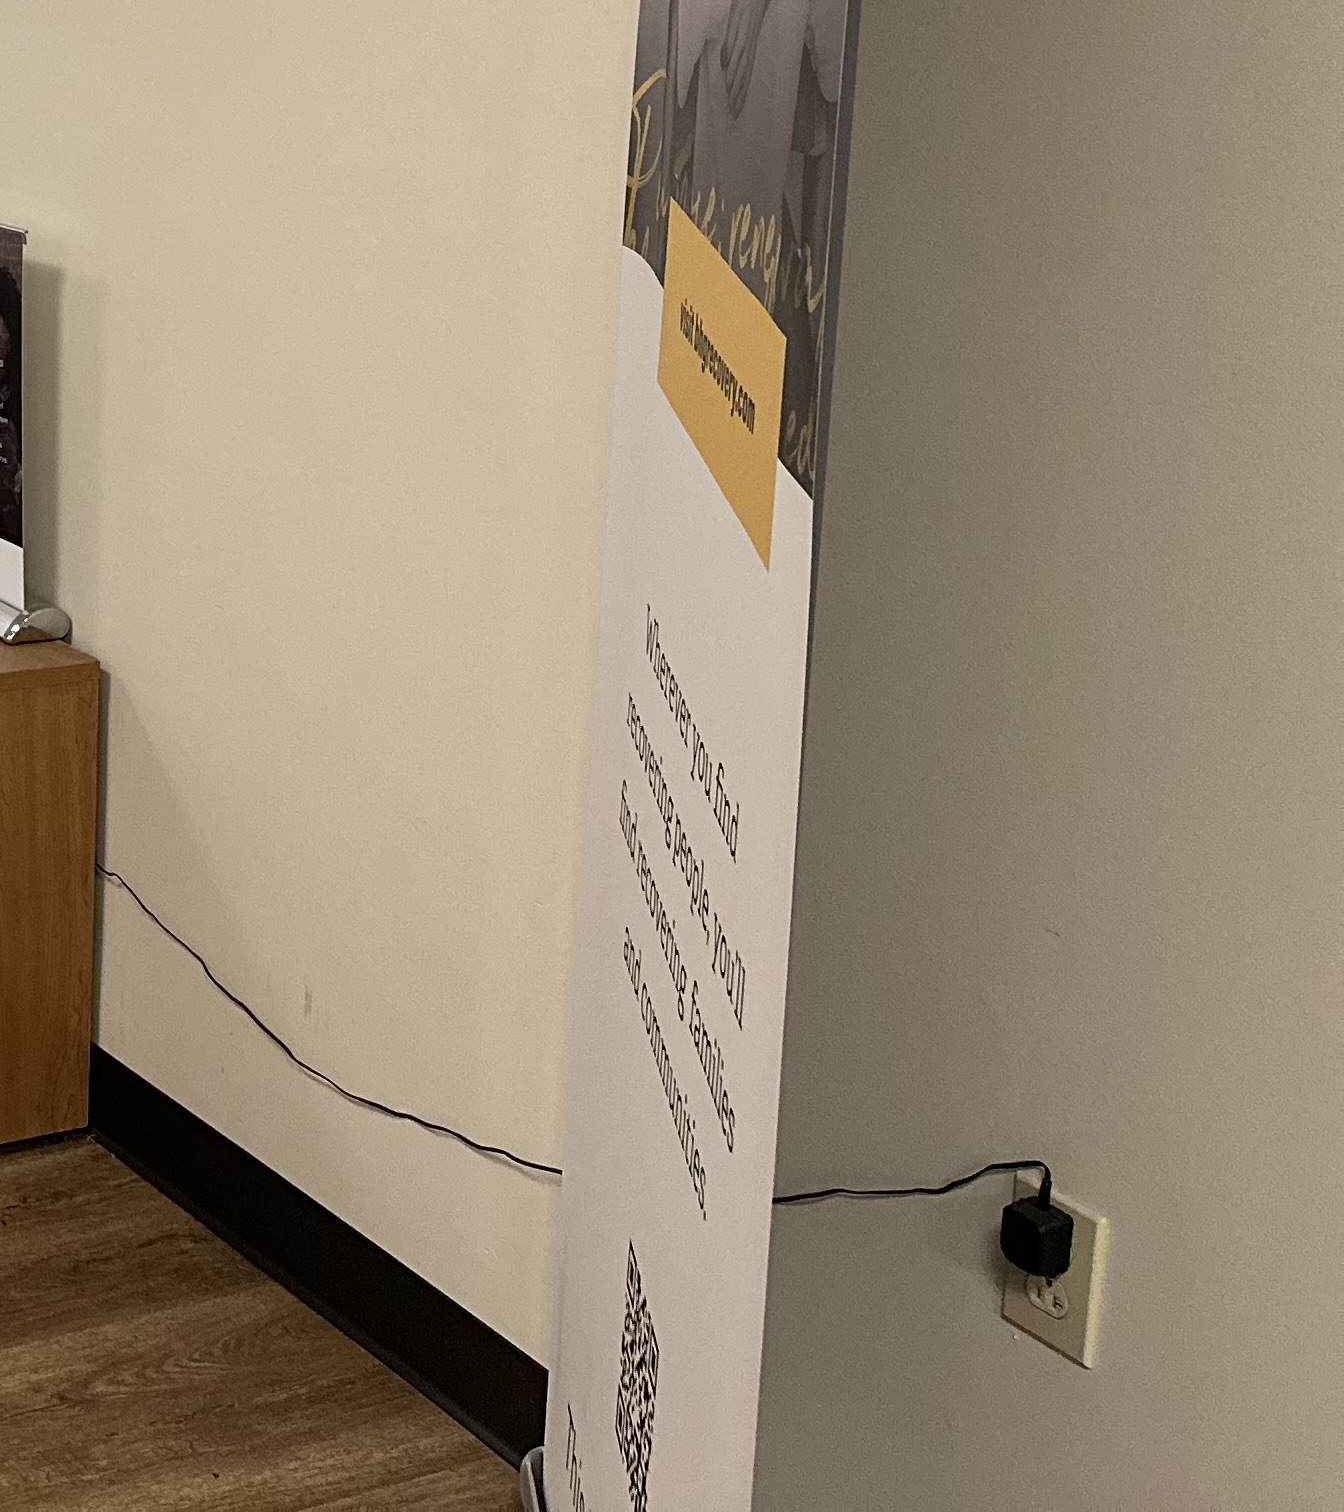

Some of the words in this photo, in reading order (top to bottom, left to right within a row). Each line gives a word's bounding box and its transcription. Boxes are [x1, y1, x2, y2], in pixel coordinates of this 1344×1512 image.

[679, 298, 693, 346] visit
[693, 313, 756, 434] bhgrecovery.com
[627, 691, 674, 850] recovering
[672, 812, 709, 946] people,
[712, 912, 746, 1031] you'll
[646, 603, 691, 748] Wherever
[691, 723, 713, 804] you
[713, 762, 740, 865] find
[619, 779, 638, 864] find
[636, 839, 687, 1022] recovering
[689, 980, 735, 1153] families
[623, 926, 642, 1001] and
[641, 982, 706, 1221] communities.
